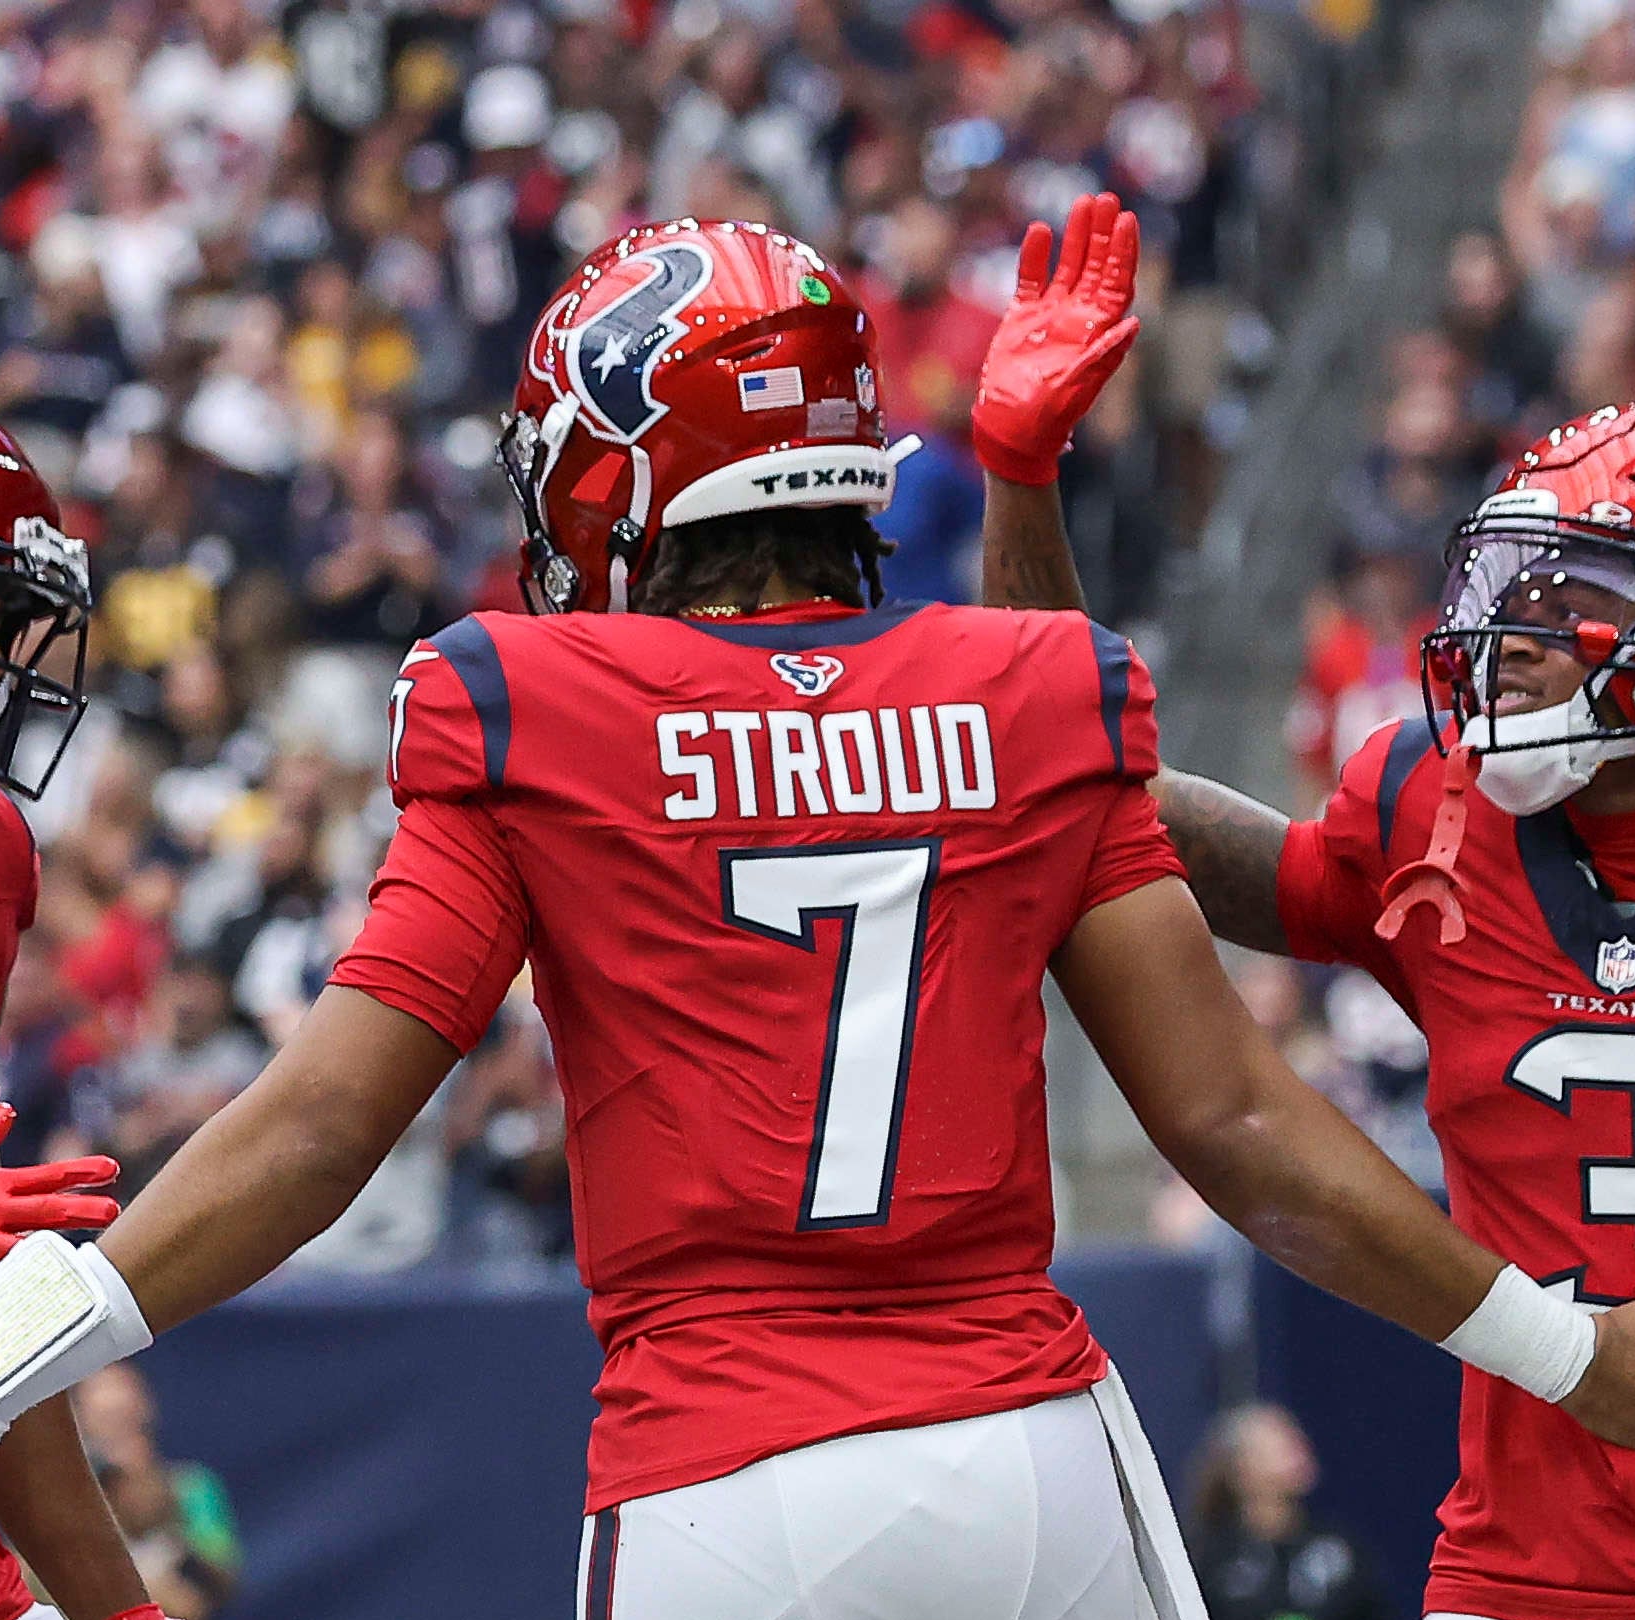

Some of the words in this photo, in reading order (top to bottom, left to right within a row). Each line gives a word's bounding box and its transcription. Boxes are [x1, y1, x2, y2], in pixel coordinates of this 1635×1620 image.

[390, 677, 416, 783] 7
[656, 702, 998, 821] STROUD
[718, 836, 941, 1232] 7
